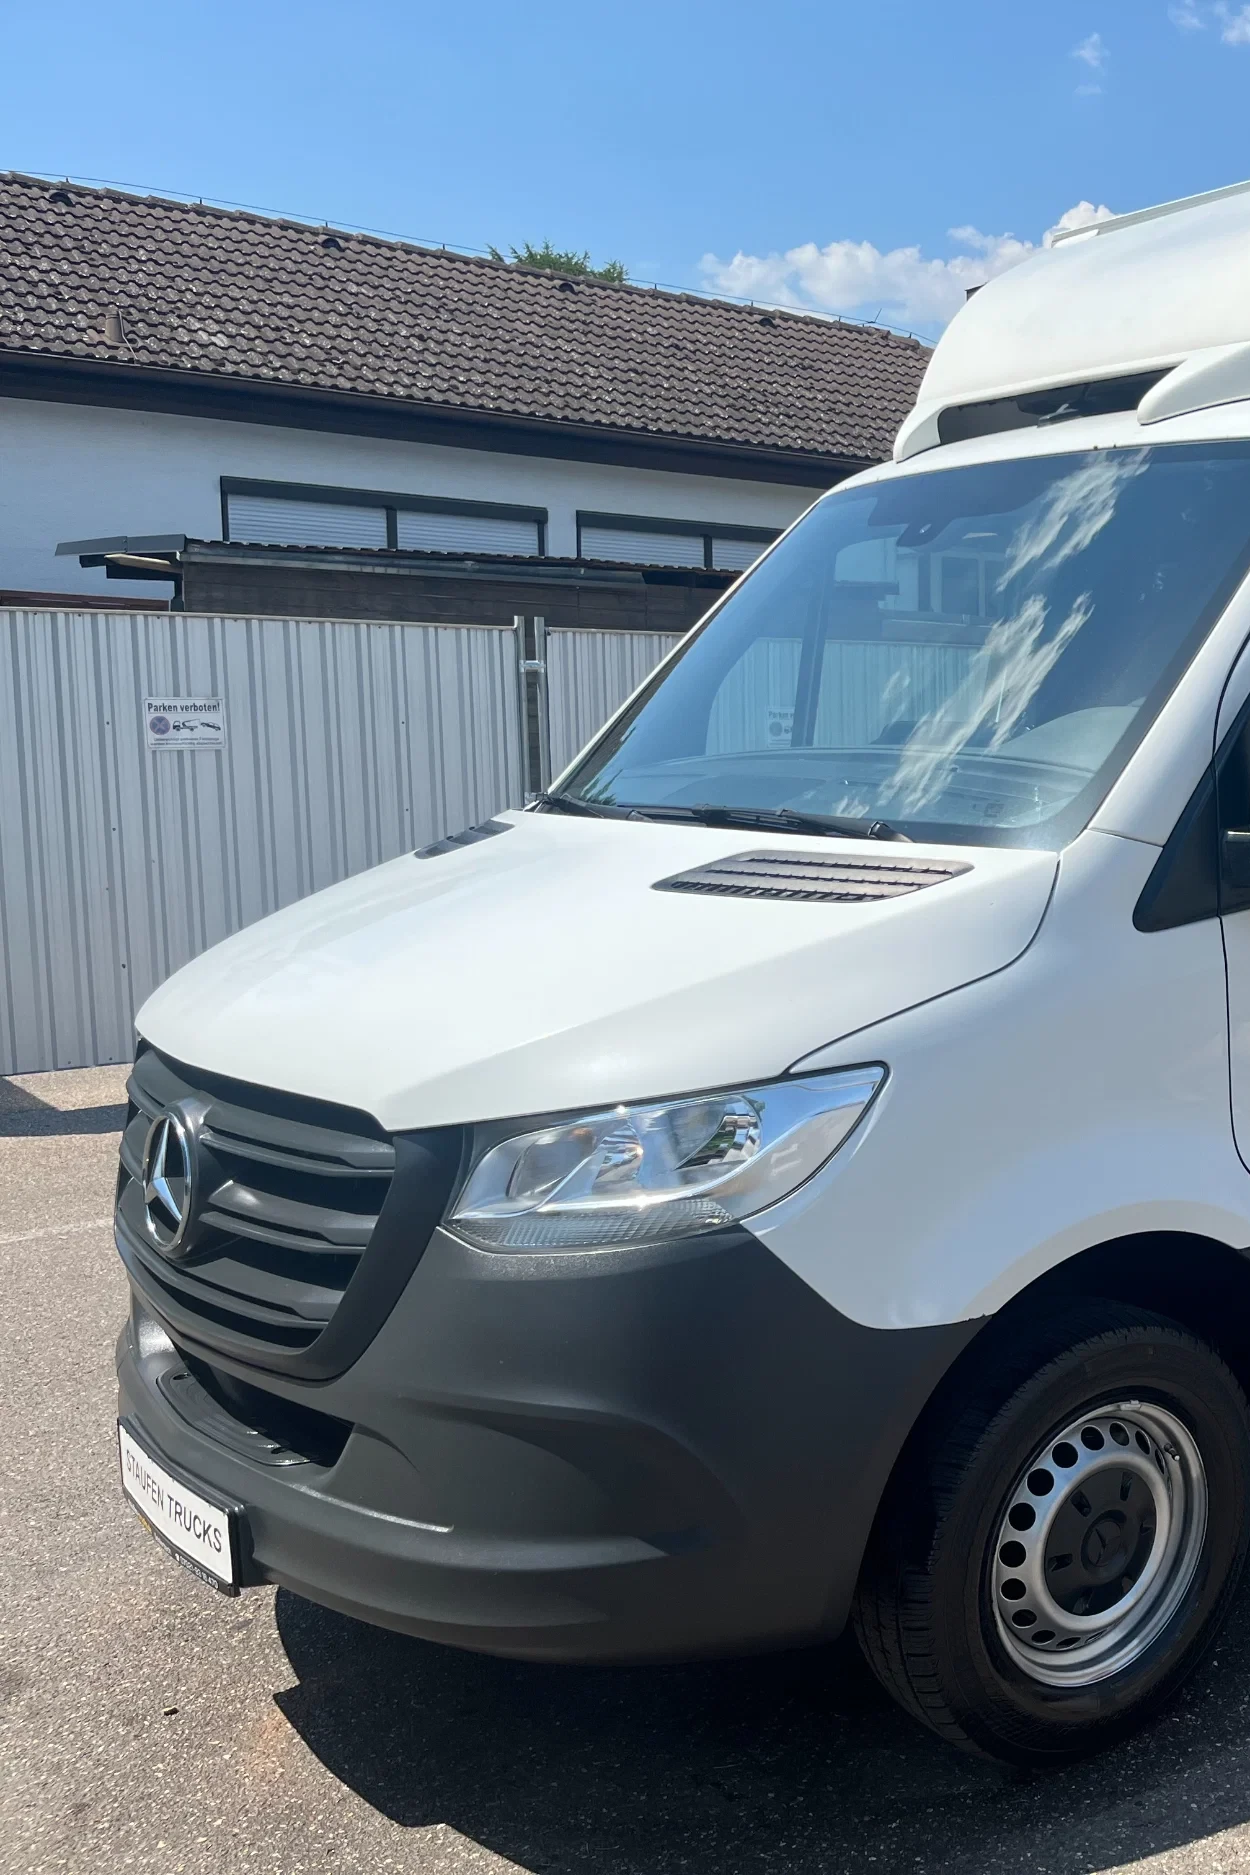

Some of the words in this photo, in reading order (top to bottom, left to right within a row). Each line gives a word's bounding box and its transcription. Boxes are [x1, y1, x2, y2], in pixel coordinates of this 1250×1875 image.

[147, 702, 178, 712] Parken
[180, 702, 220, 712] verboten!
[126, 1449, 164, 1511] STAUFEN
[167, 1494, 222, 1553] TRUCKS
